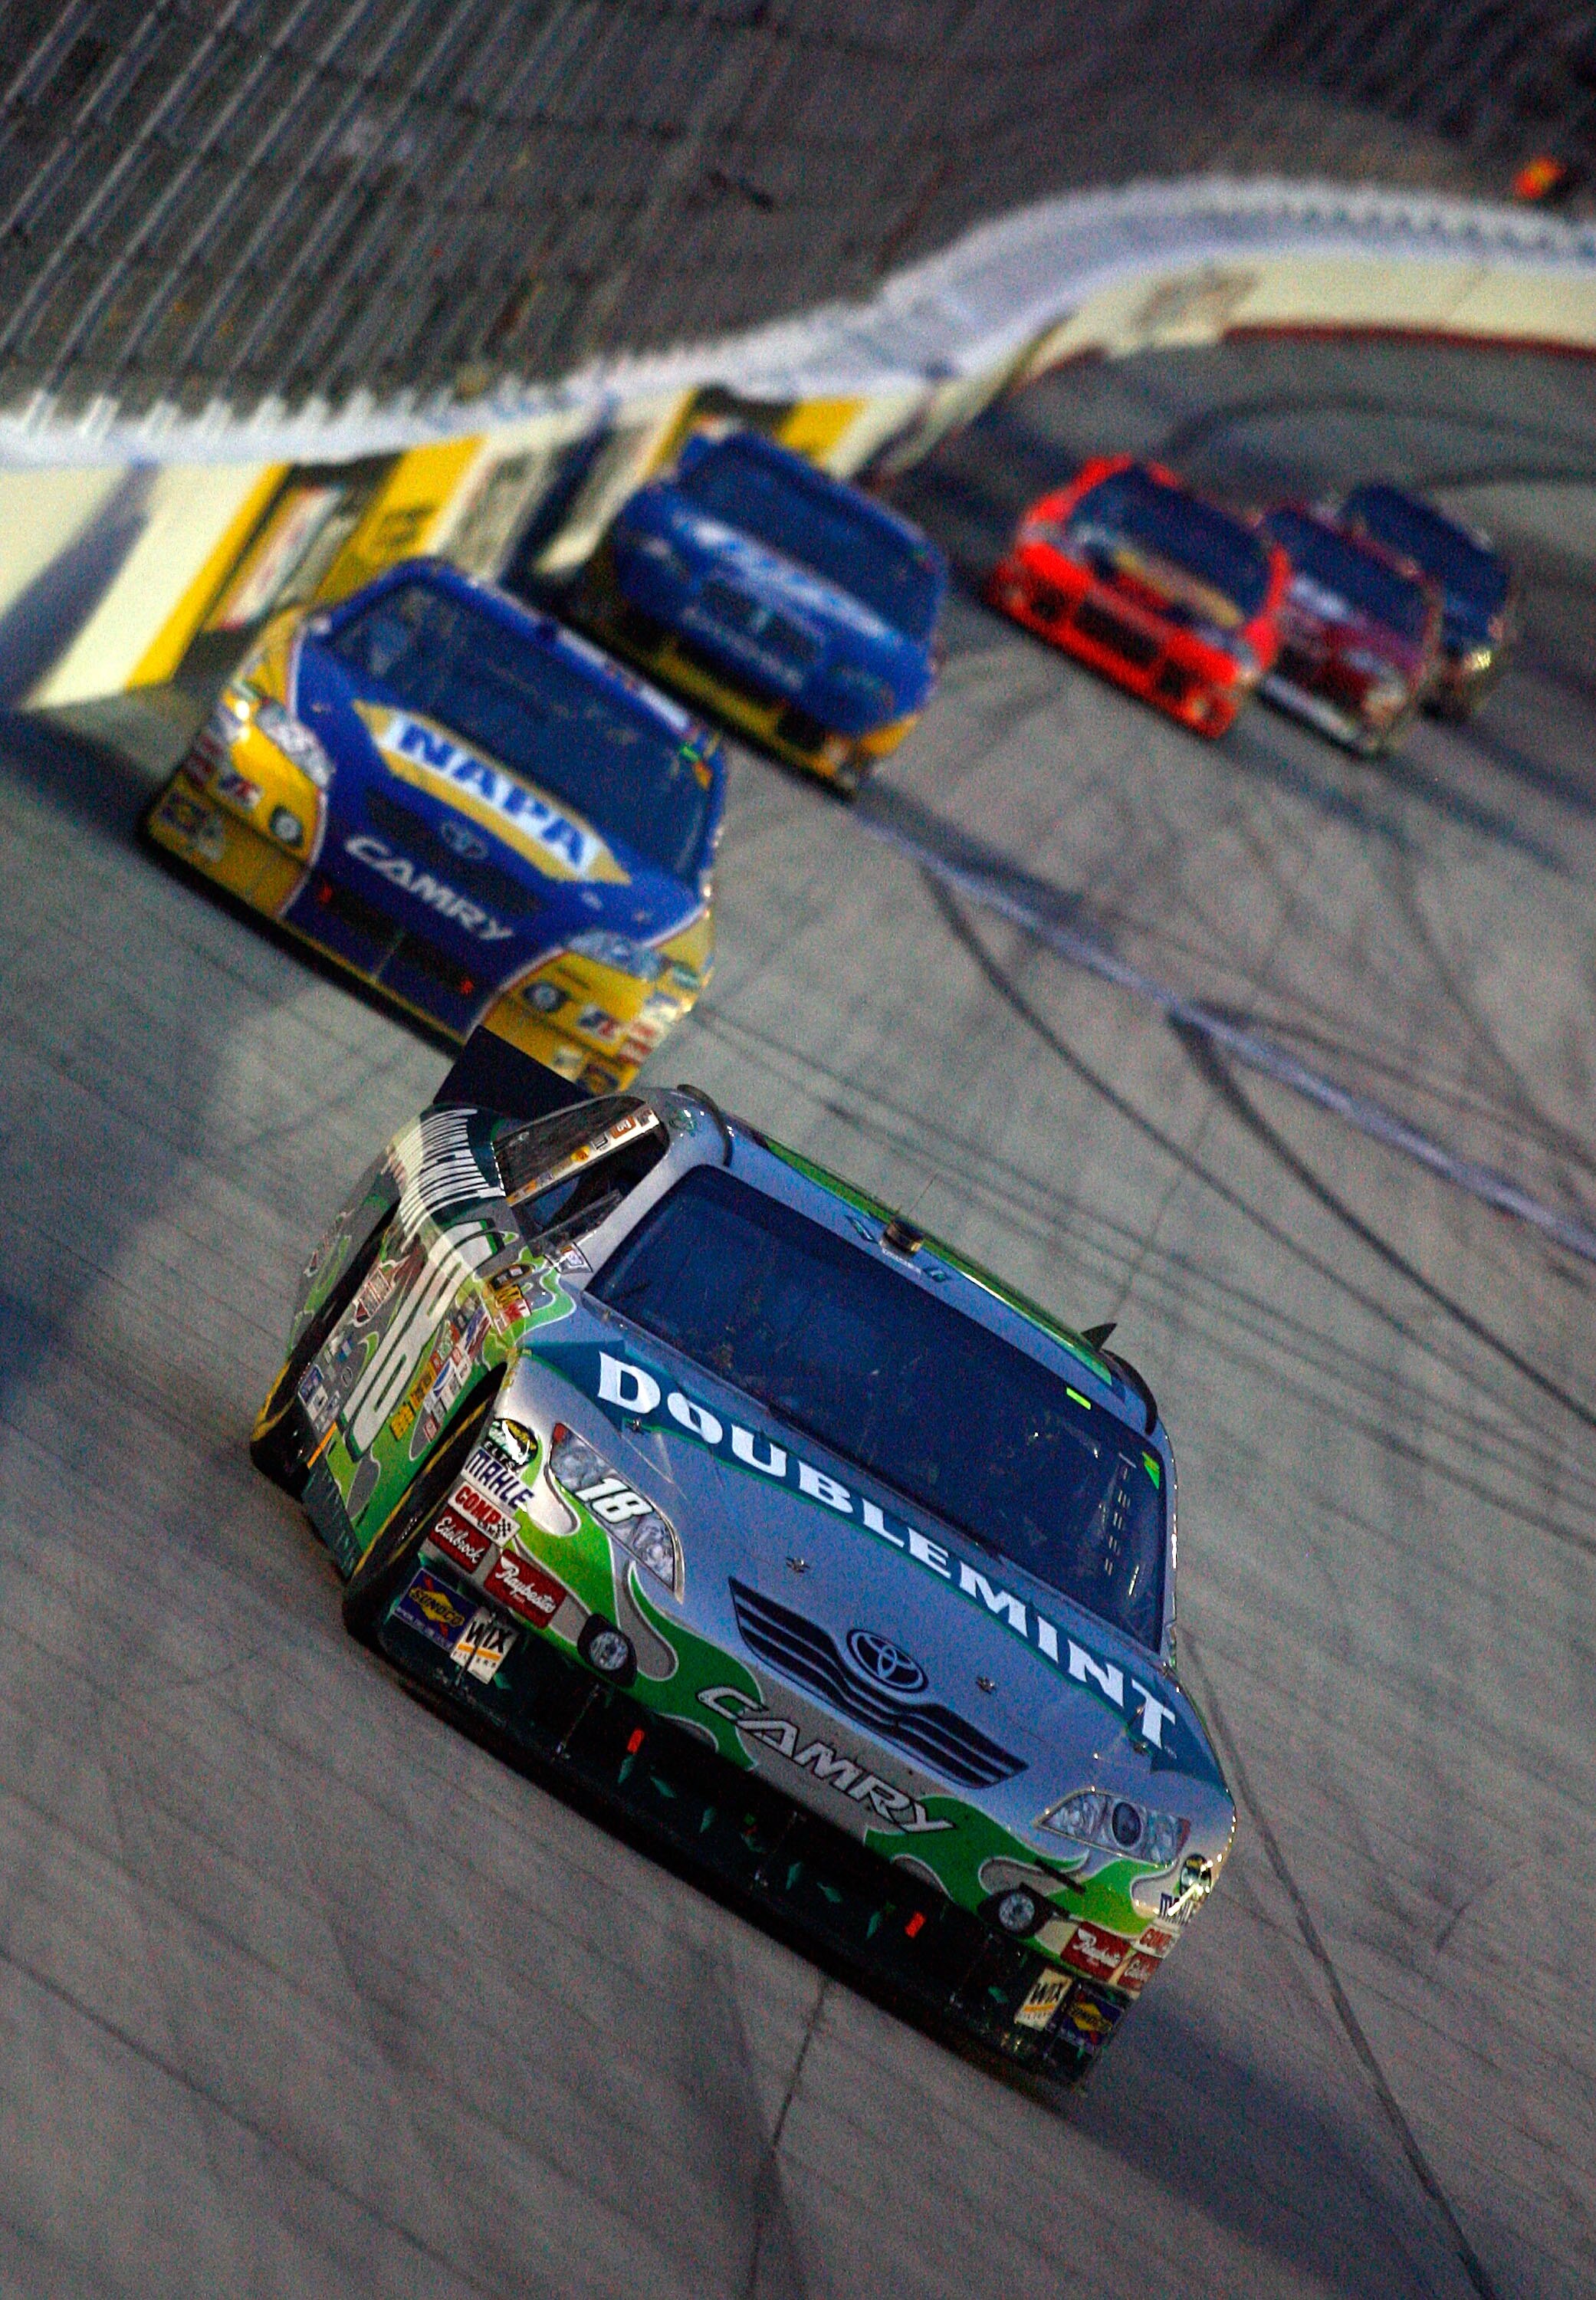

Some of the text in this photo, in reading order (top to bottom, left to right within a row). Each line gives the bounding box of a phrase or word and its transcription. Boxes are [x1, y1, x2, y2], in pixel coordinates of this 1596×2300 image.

[398, 723, 584, 866] NAPA
[345, 834, 514, 941] CAMRY
[340, 1217, 500, 1458] 18
[455, 1486, 501, 1526] COMP
[464, 1447, 535, 1510] MAHLE
[573, 1477, 653, 1524] 18
[435, 1516, 485, 1564] Edelbrock
[597, 1352, 1177, 1751] DOUBLEMINT
[465, 1619, 512, 1654] WIX
[696, 1686, 956, 1835] CAMRY
